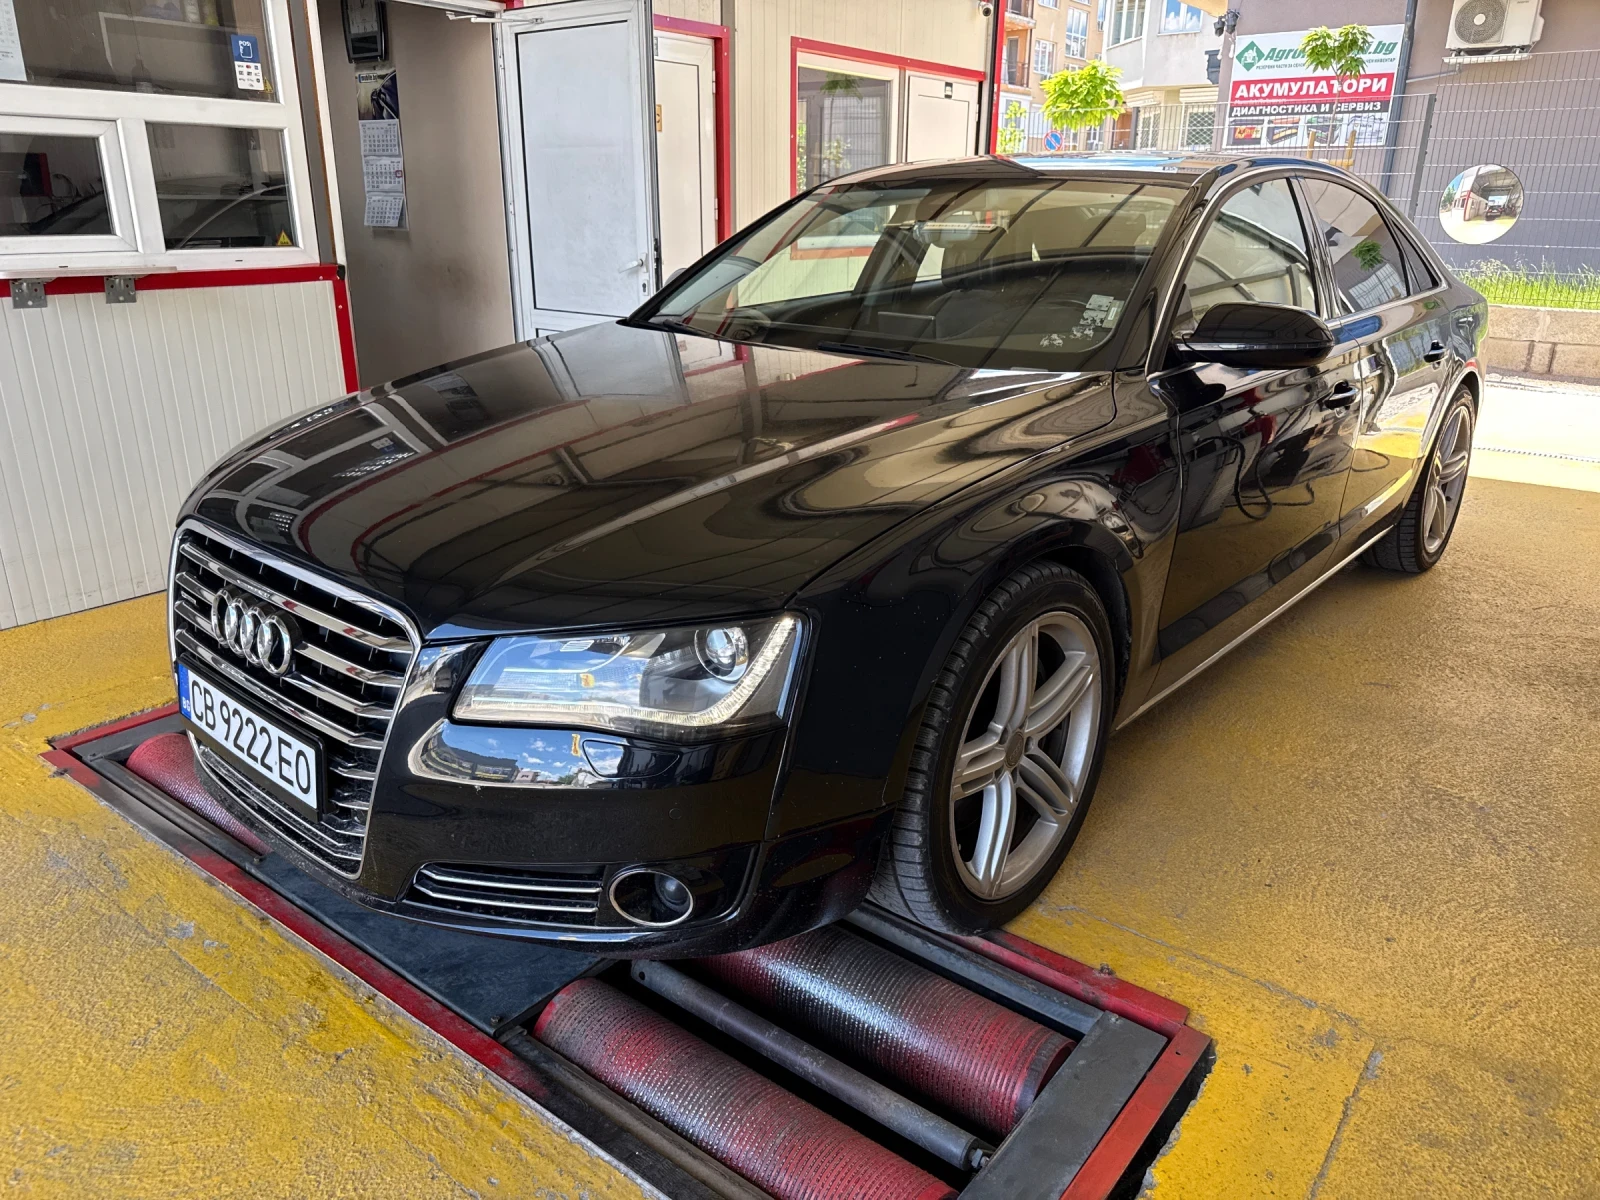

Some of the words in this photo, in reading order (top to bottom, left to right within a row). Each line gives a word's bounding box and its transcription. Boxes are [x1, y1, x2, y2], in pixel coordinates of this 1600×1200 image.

[1235, 77, 1388, 98] АКУМУЛАТОРИ
[1231, 104, 1317, 116] ДИАГНОСТИКА
[1320, 103, 1330, 112] И
[182, 696, 190, 712] BG
